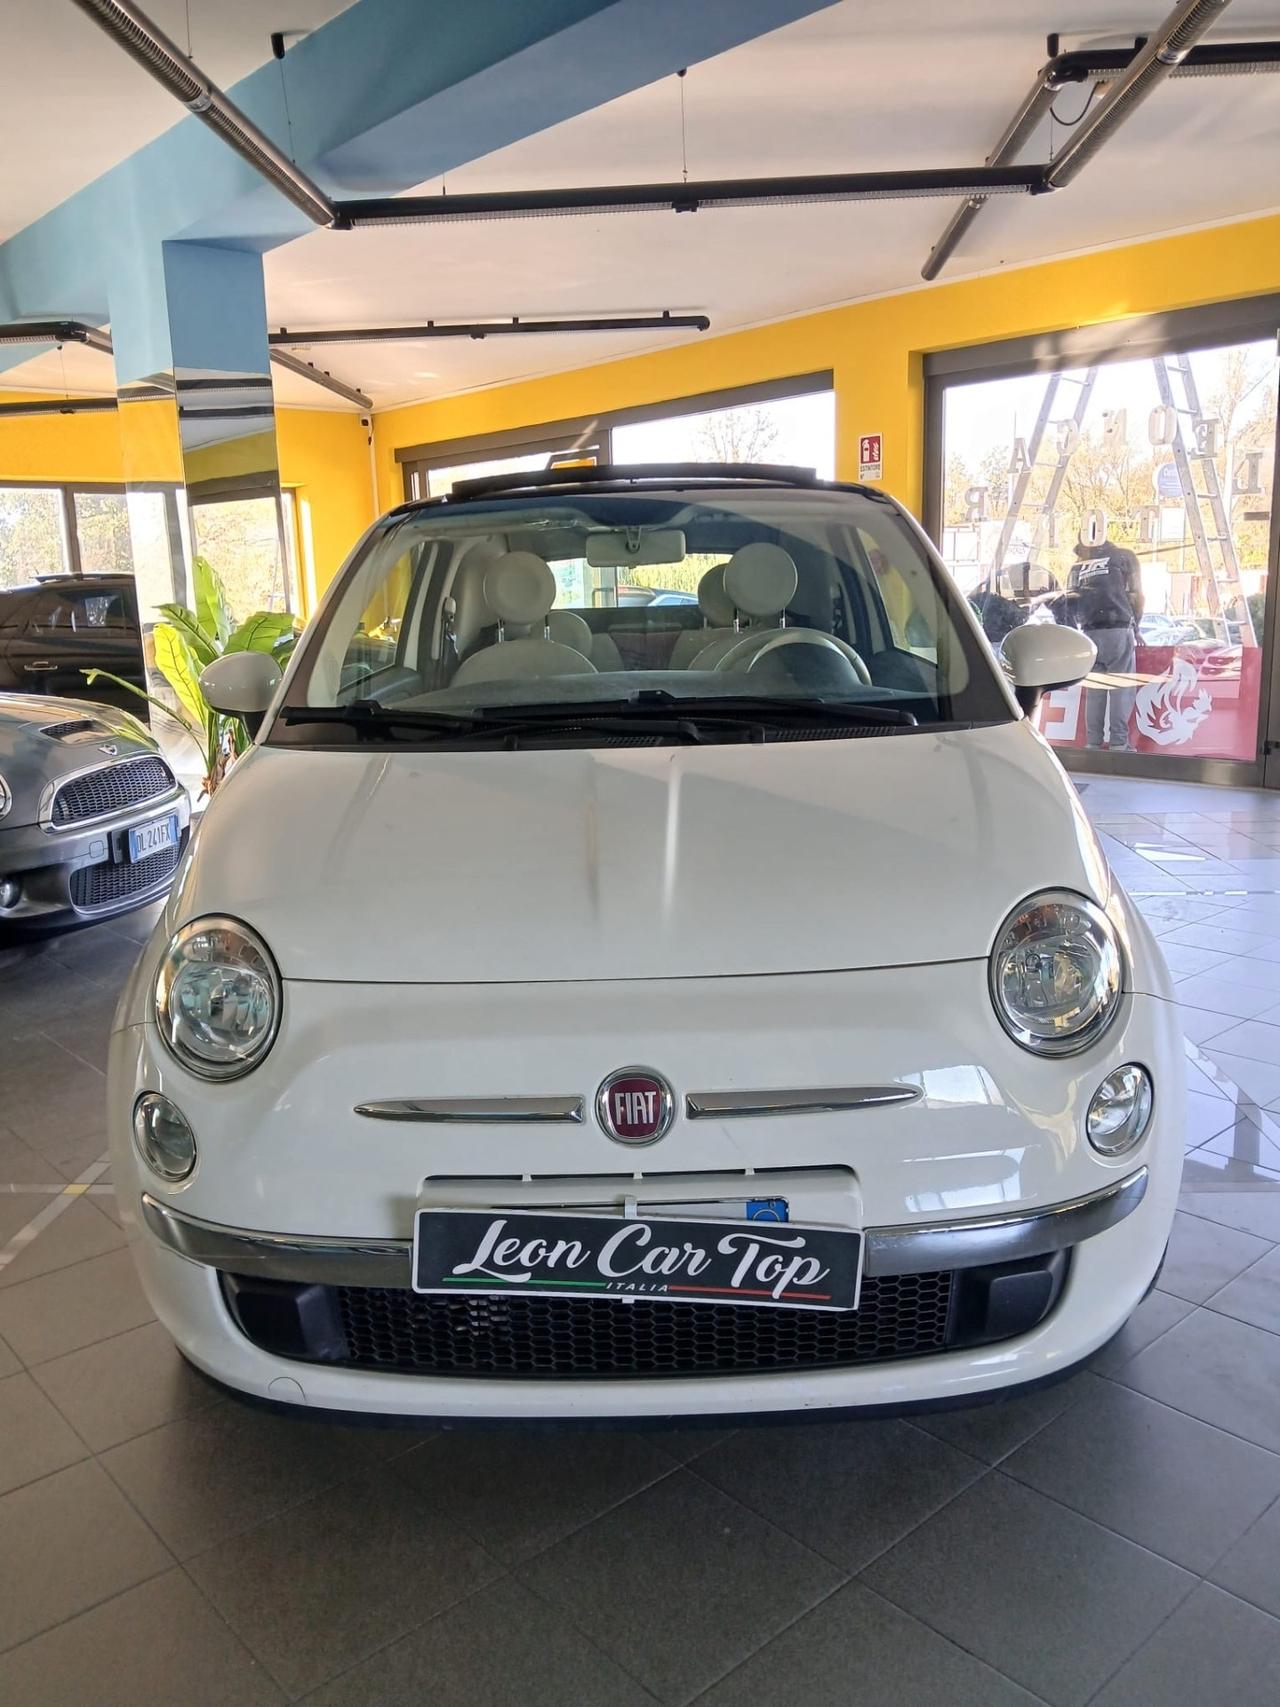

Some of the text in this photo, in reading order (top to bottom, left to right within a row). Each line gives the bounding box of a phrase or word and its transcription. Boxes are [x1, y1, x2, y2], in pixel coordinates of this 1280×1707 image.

[136, 833, 146, 852] DL
[614, 1091, 657, 1125] FIAT
[452, 1219, 831, 1300] Leon Car Top
[605, 1281, 669, 1293] ITALIA
